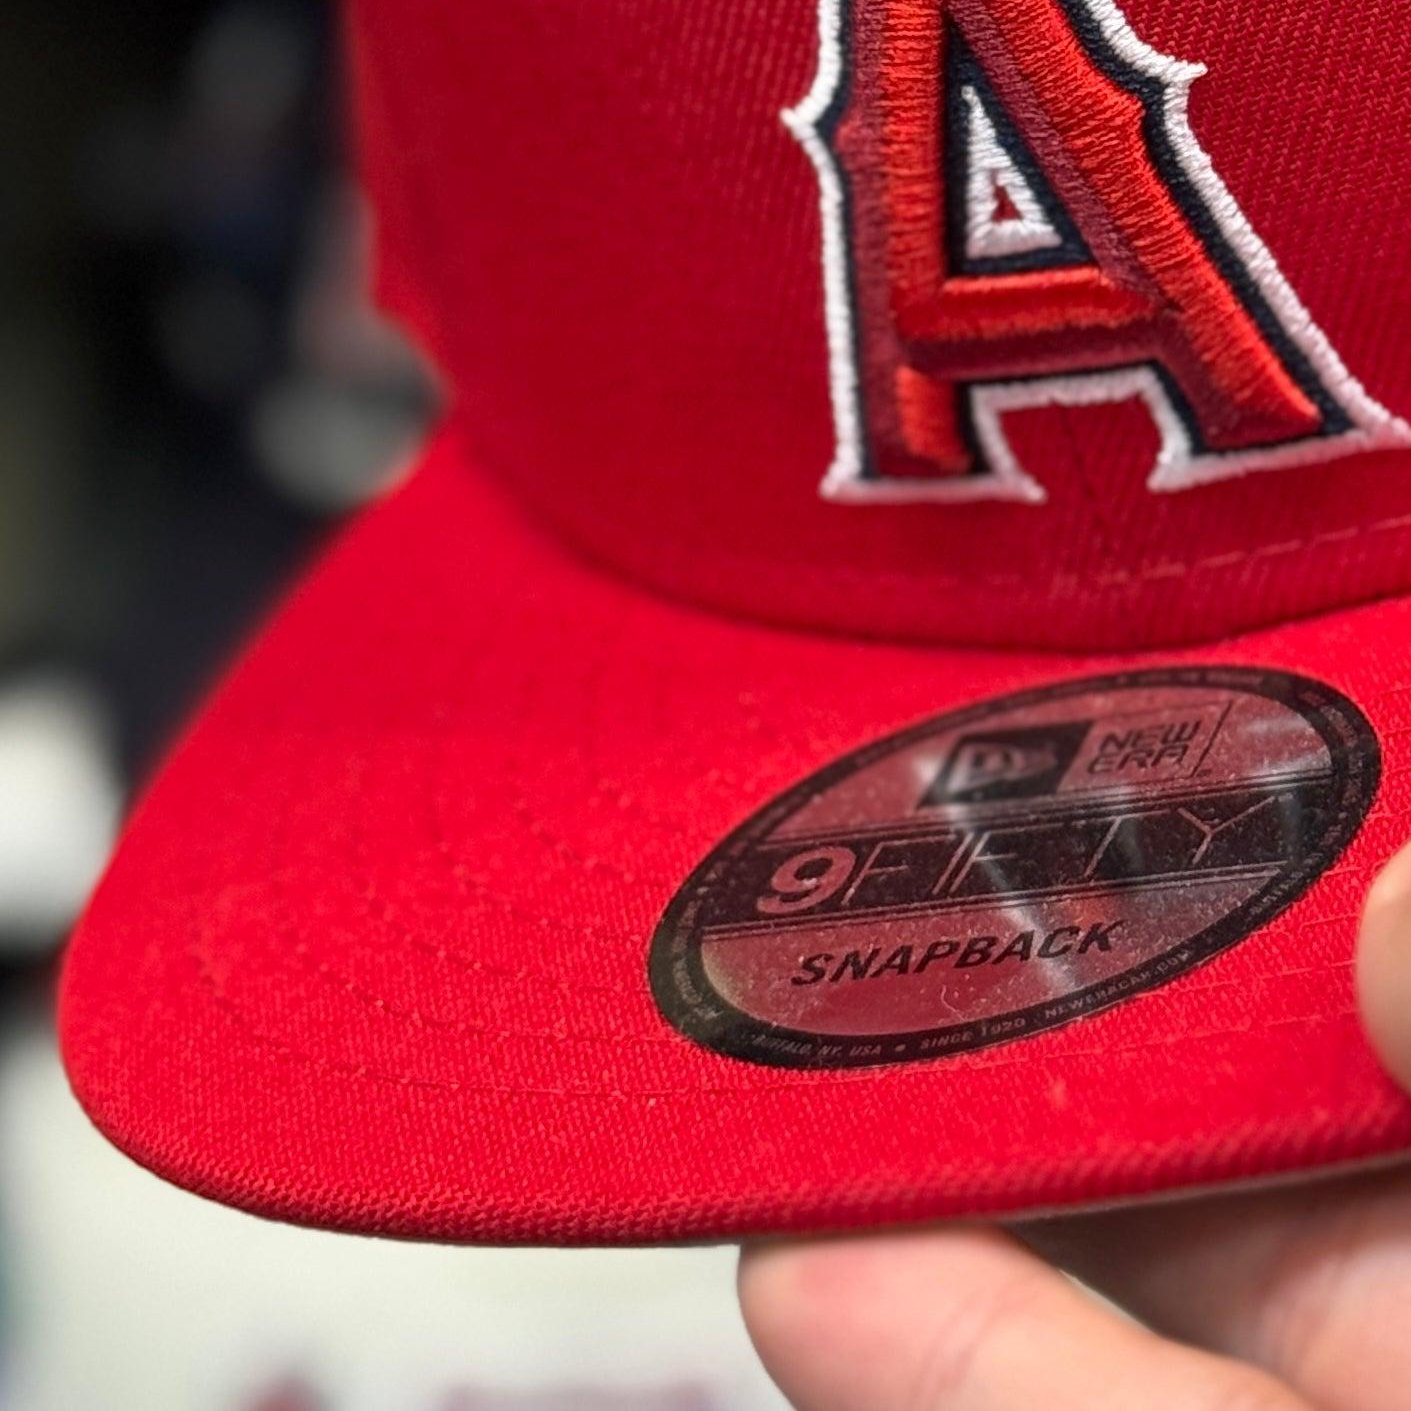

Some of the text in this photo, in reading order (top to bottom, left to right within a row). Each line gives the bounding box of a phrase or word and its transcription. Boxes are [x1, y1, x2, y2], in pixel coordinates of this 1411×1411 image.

[1100, 720, 1202, 752] NEW
[1087, 744, 1188, 774] ERA
[756, 795, 1278, 915] 9FIFTY
[791, 920, 1127, 987] SNAPBACK
[849, 1044, 883, 1057] USA
[919, 1030, 974, 1050] SINCE
